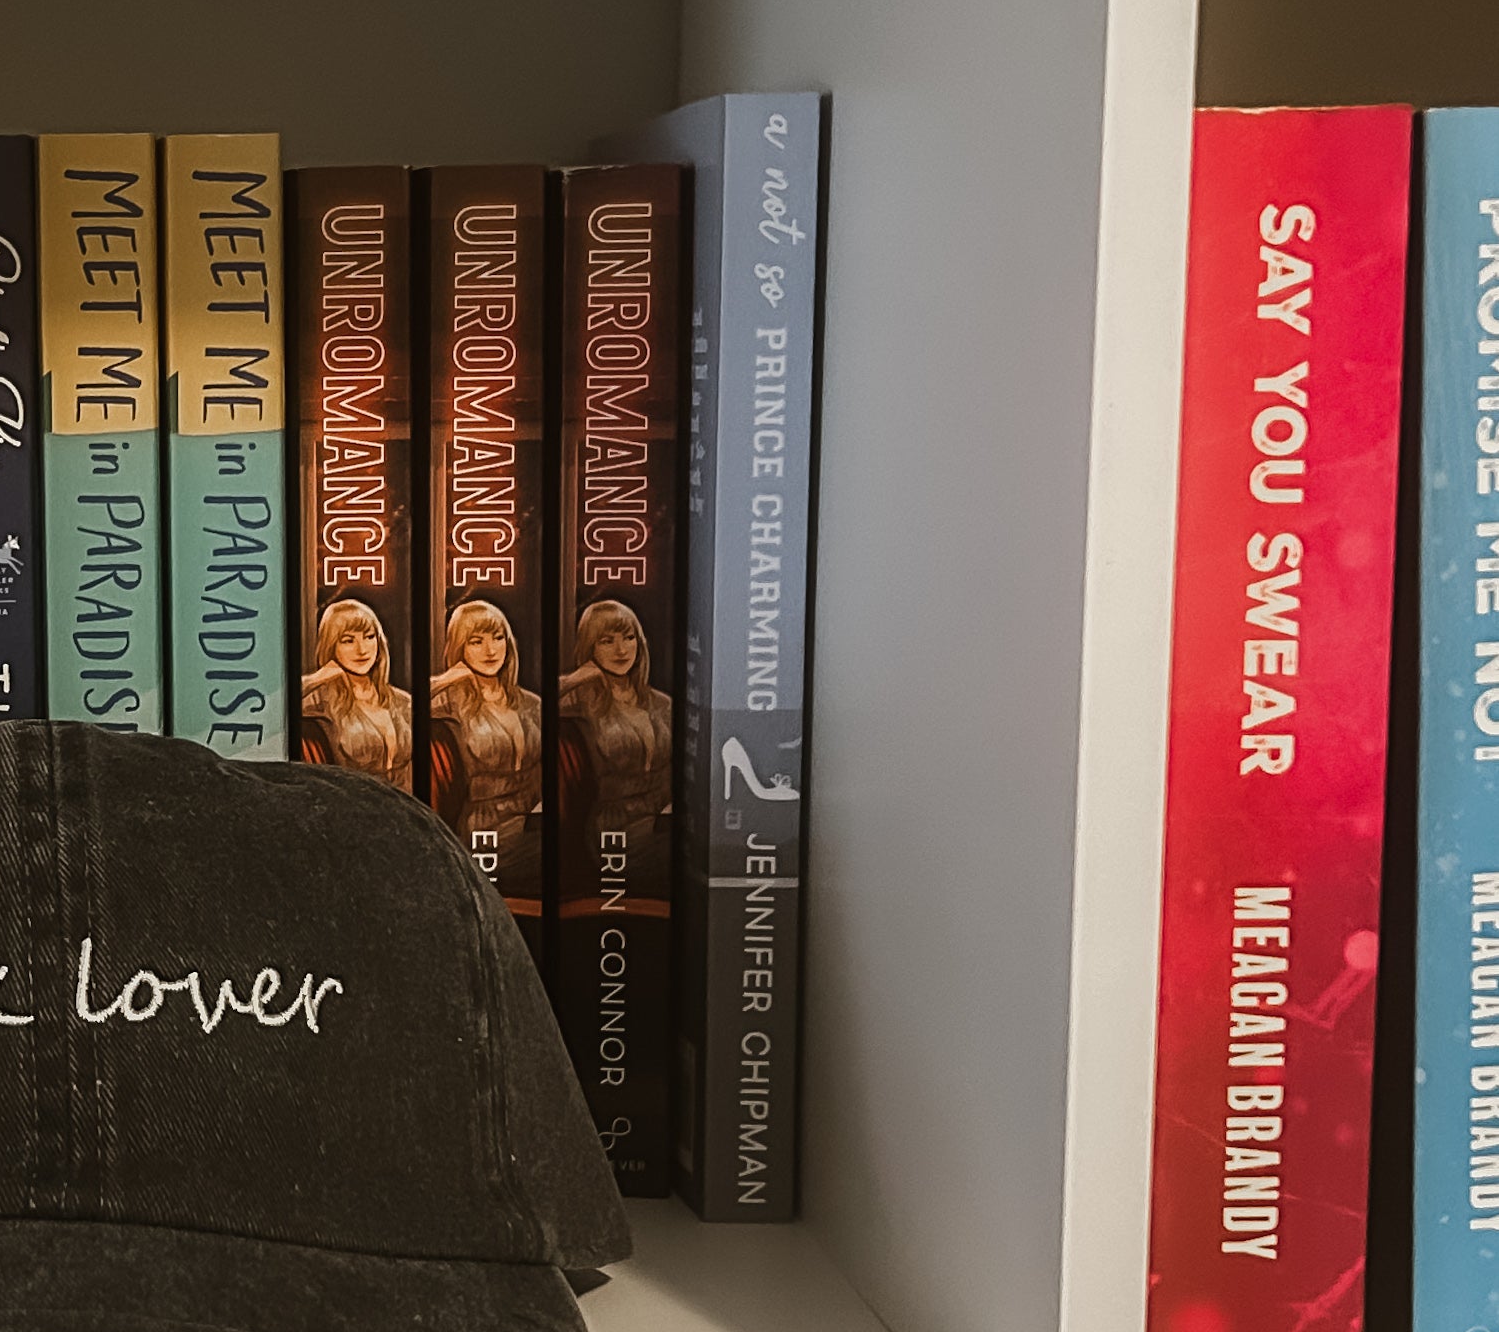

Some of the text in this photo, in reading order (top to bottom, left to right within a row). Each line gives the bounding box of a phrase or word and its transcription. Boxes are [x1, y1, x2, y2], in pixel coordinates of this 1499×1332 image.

[64, 169, 143, 324] MEET
[753, 261, 787, 310] so
[758, 167, 806, 246] not
[76, 346, 143, 424] ME
[89, 441, 130, 474] in
[192, 169, 271, 748] MEET ME in PARADISE
[321, 204, 386, 587] UNROMANCE
[452, 203, 518, 587] UNROMANCE
[750, 327, 788, 479] PRINCE
[1239, 203, 1317, 776] SAY YOU SWEAR
[583, 202, 653, 1086] UNROMANCE ERIN CONNOR
[746, 492, 785, 713] CHARMING
[76, 937, 343, 1033] lover
[737, 834, 777, 1204] JENNIFER CHIPMAN
[1221, 886, 1292, 1260] MEAGAN BRANDY
